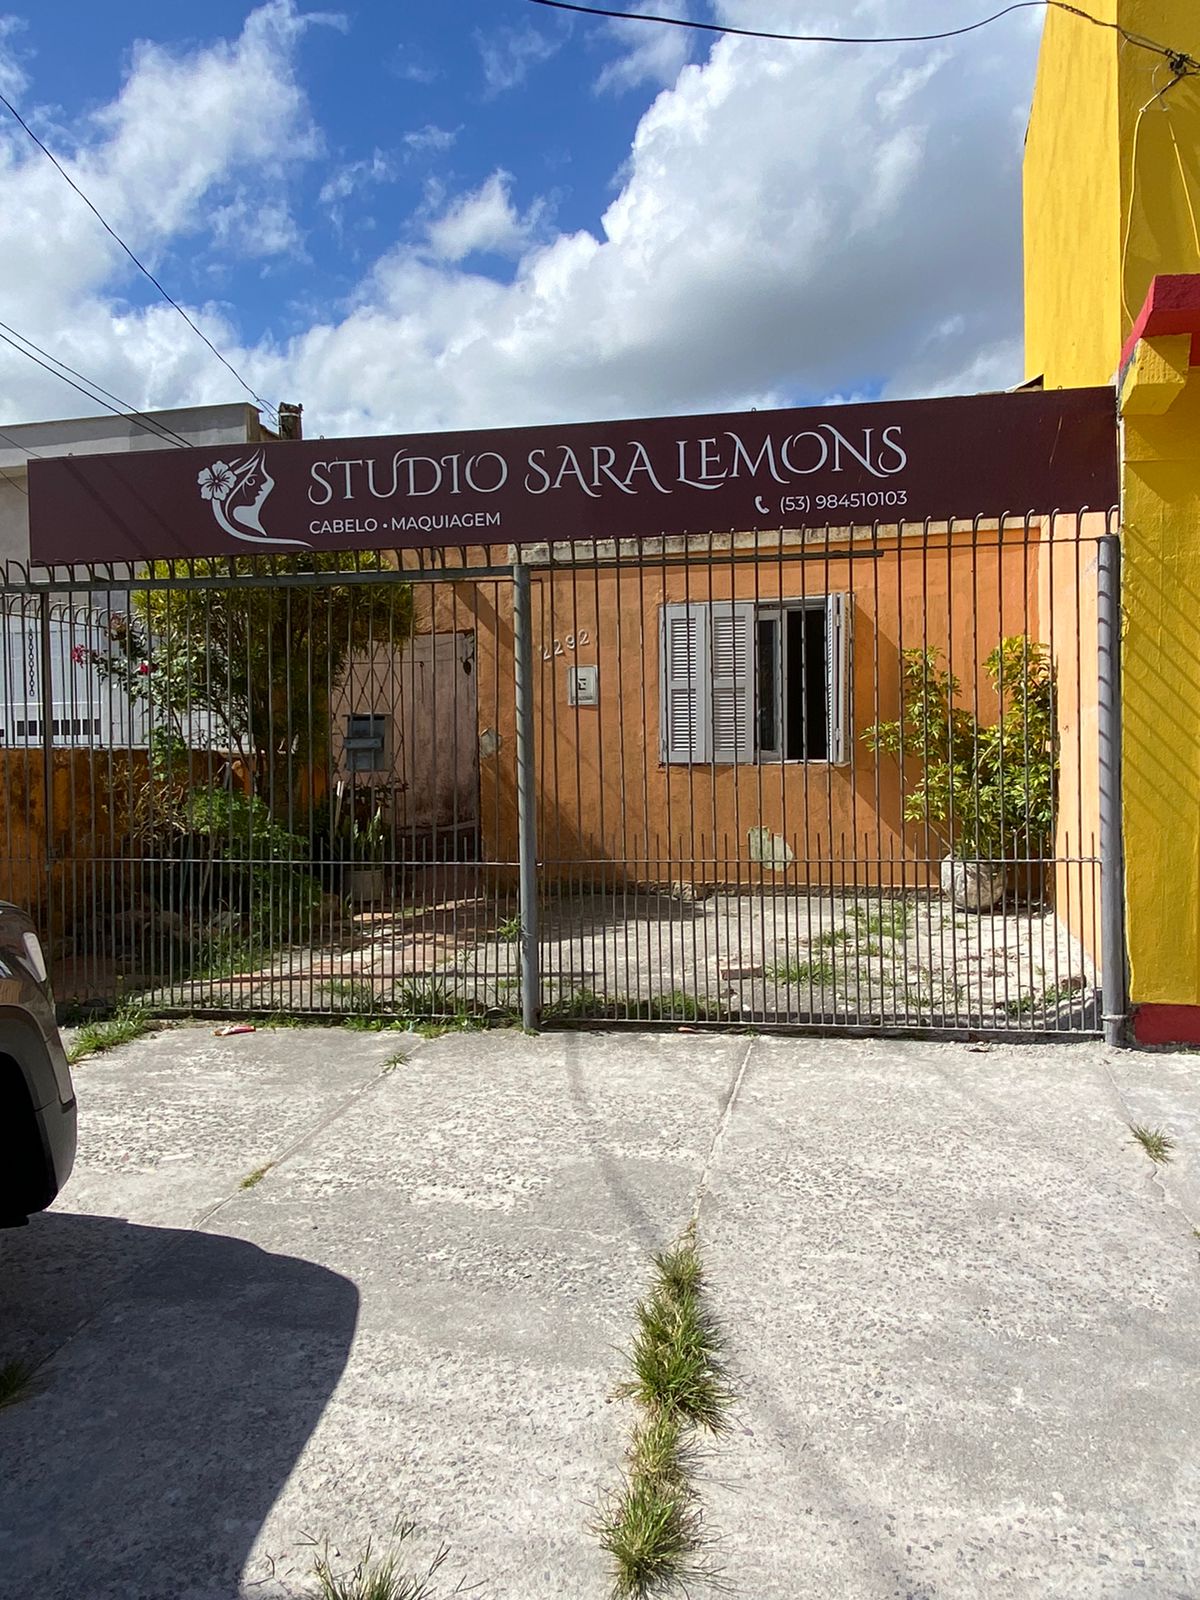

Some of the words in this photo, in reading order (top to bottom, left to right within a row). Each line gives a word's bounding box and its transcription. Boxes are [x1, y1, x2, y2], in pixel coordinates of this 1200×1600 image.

[308, 449, 507, 504] STUDIO
[525, 442, 672, 497] SARA
[677, 424, 906, 491] LEMONS
[780, 495, 811, 514] (53)
[815, 491, 907, 510] 984510103
[310, 518, 377, 534] CABELO
[392, 512, 500, 532] MAQUIAGEM
